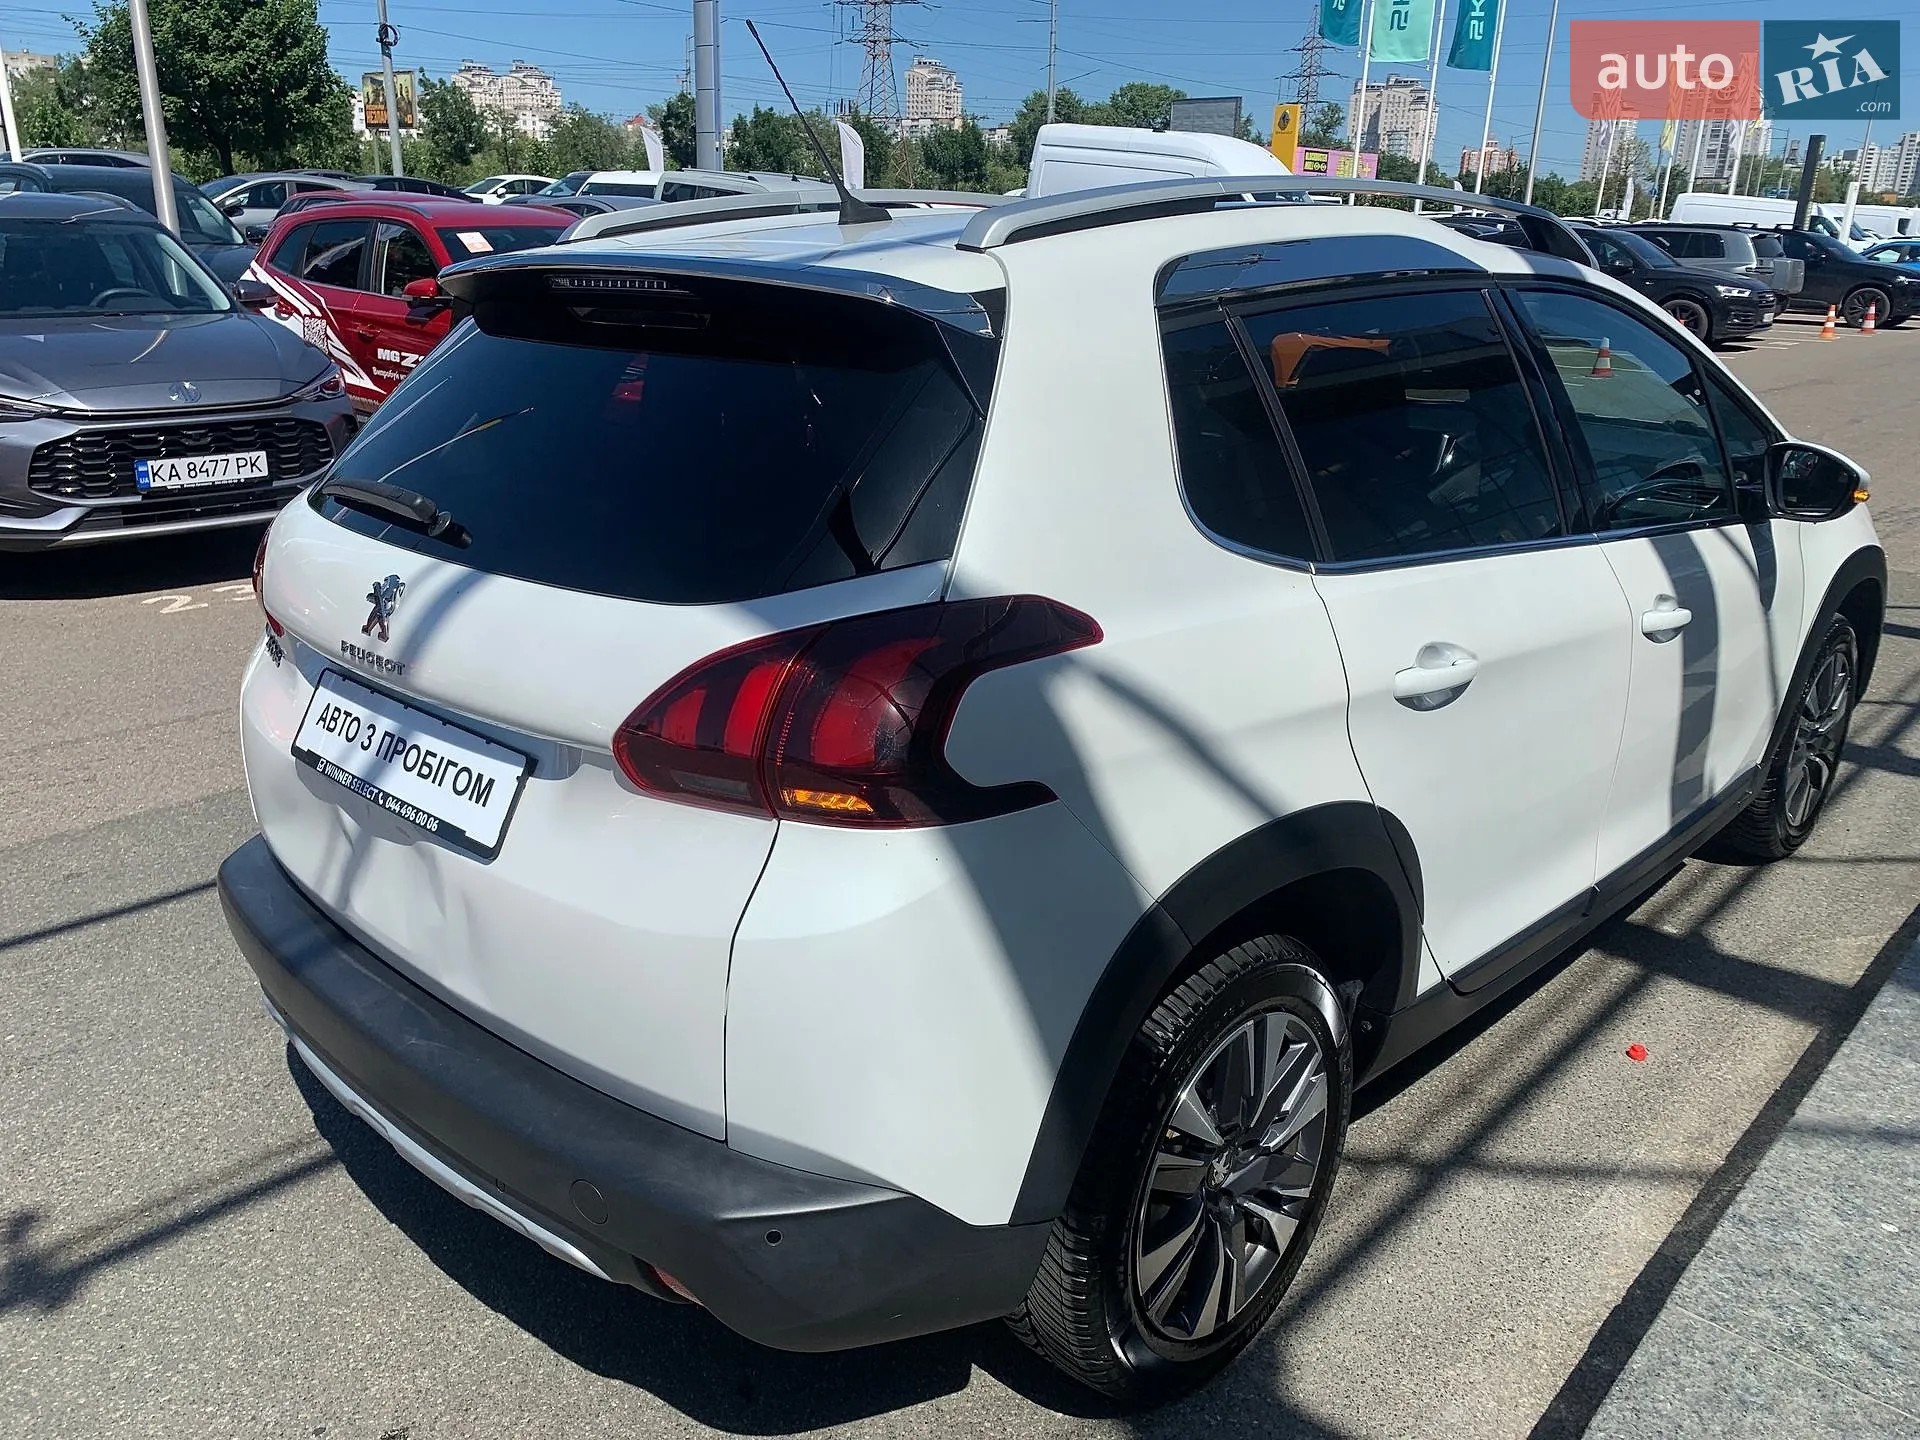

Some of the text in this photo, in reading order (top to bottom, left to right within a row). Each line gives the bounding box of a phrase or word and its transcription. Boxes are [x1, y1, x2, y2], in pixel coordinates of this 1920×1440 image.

[377, 348, 425, 368] MG Z
[150, 455, 263, 483] KA 8477 PK
[341, 640, 405, 675] PEUGEOT
[316, 703, 361, 742] АВТО
[375, 730, 496, 807] ПРОБІГОМ
[324, 761, 440, 832] WINNER SELECT 044 496 00 06
